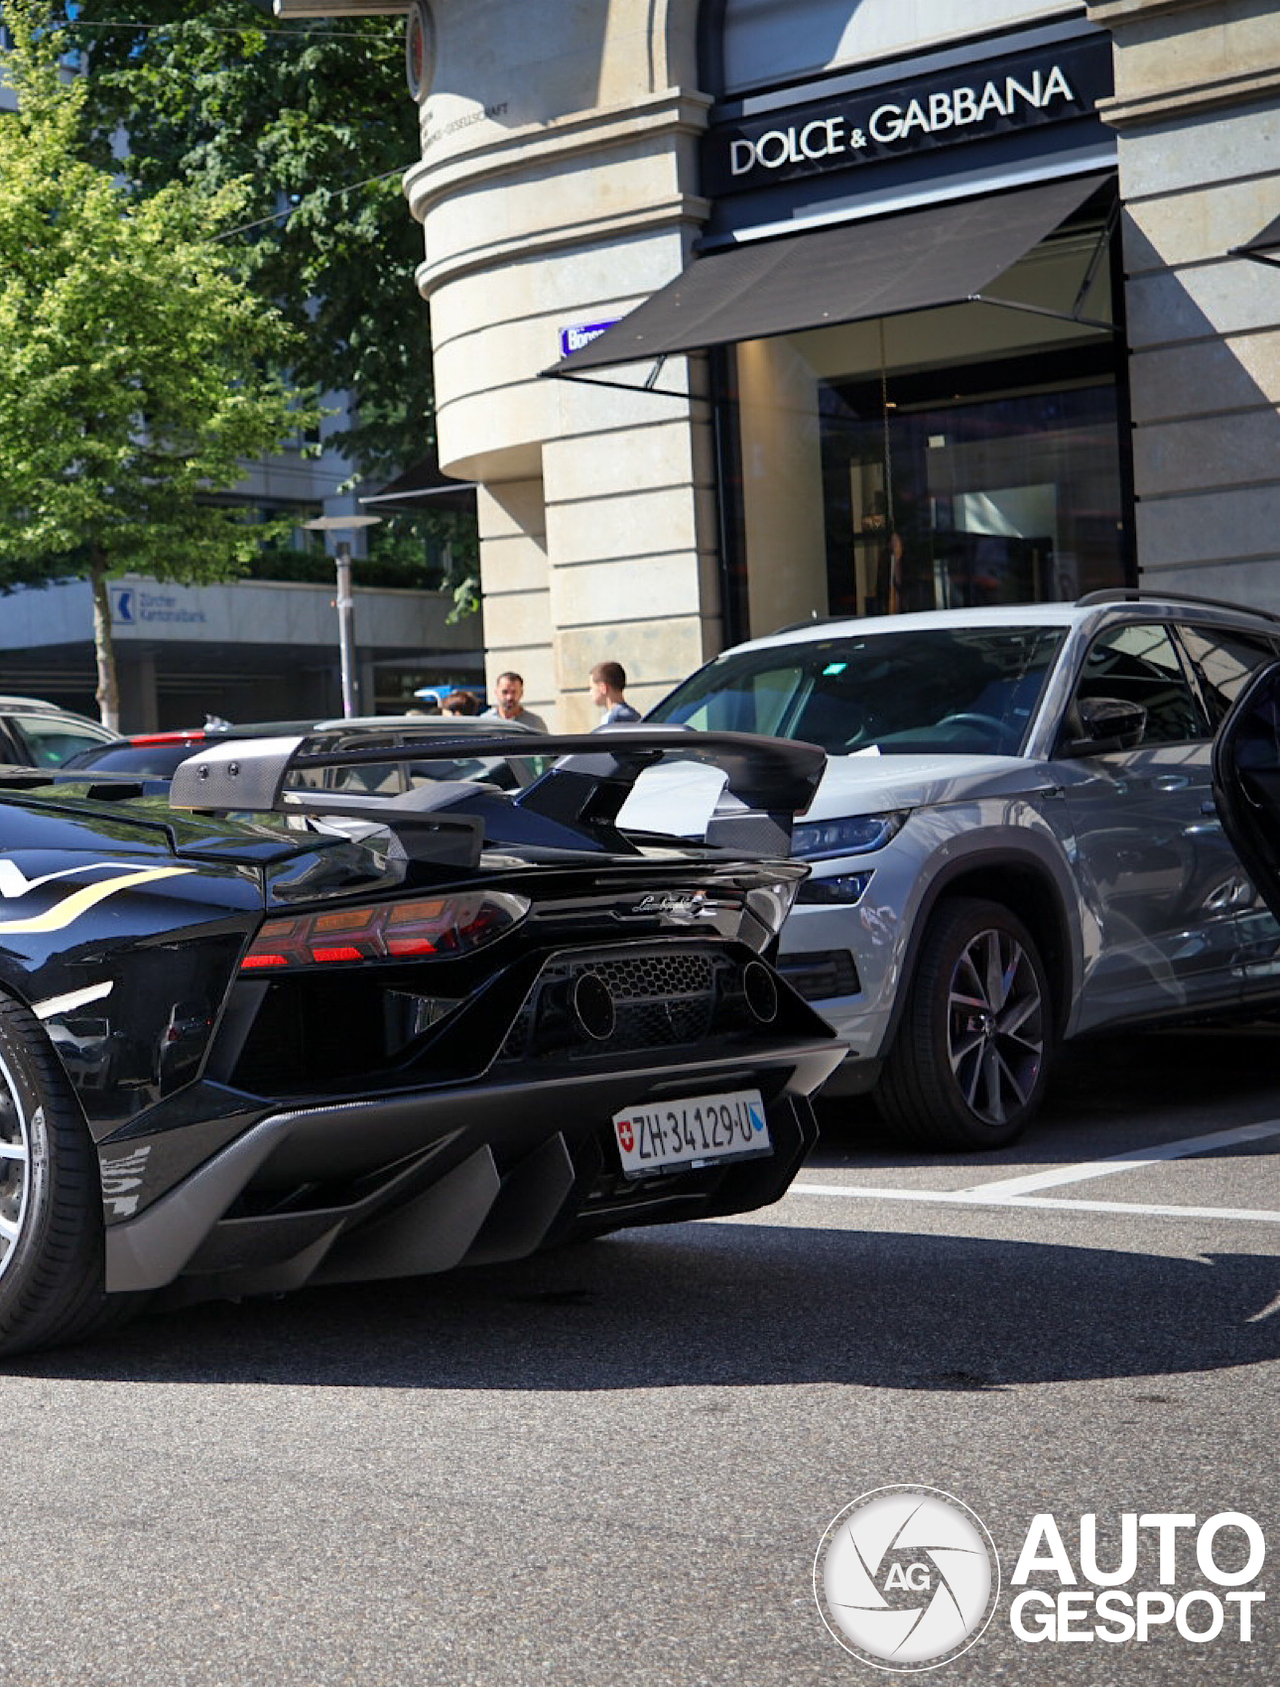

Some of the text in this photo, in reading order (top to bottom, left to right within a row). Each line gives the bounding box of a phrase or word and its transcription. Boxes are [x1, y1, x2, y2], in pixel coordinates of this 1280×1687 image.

[731, 65, 1074, 175] DOLCE & GABBANA
